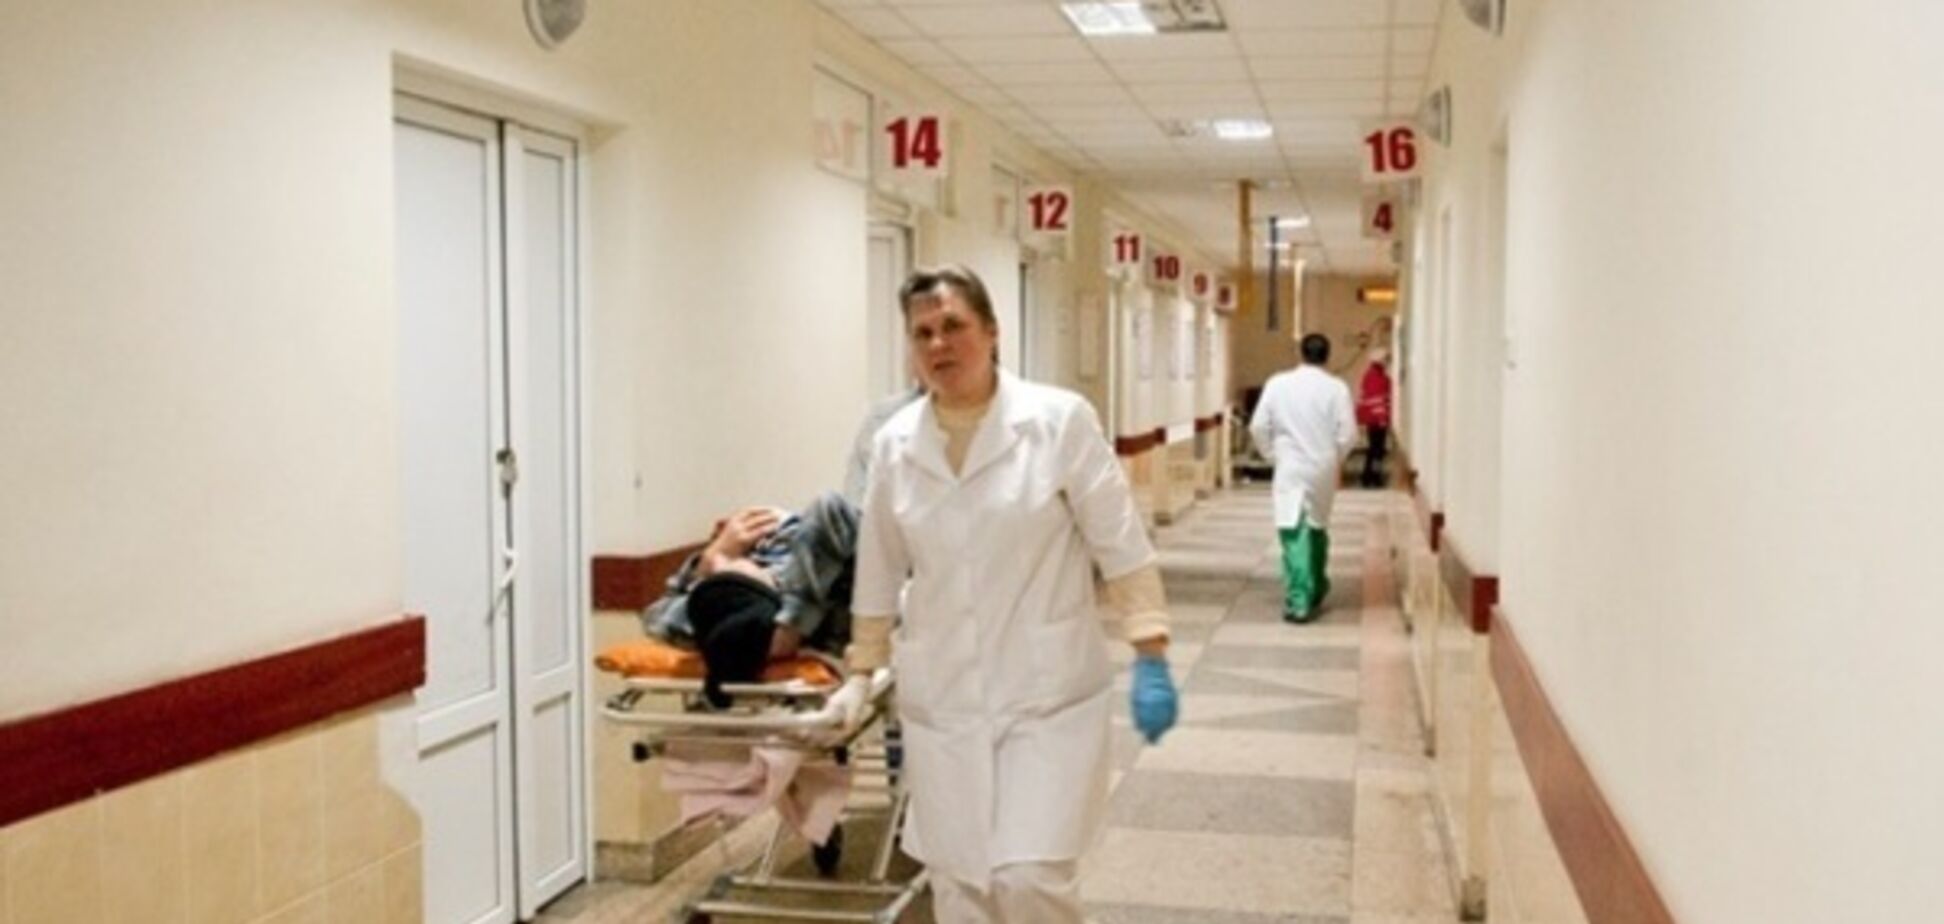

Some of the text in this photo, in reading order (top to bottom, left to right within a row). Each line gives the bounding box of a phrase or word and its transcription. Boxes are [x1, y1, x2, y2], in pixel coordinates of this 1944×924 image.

[884, 116, 942, 169] 14
[1364, 126, 1417, 173] 16
[1027, 191, 1068, 231] 12
[1373, 202, 1394, 233] 4
[1114, 234, 1140, 263] 11
[1154, 255, 1180, 280] 10
